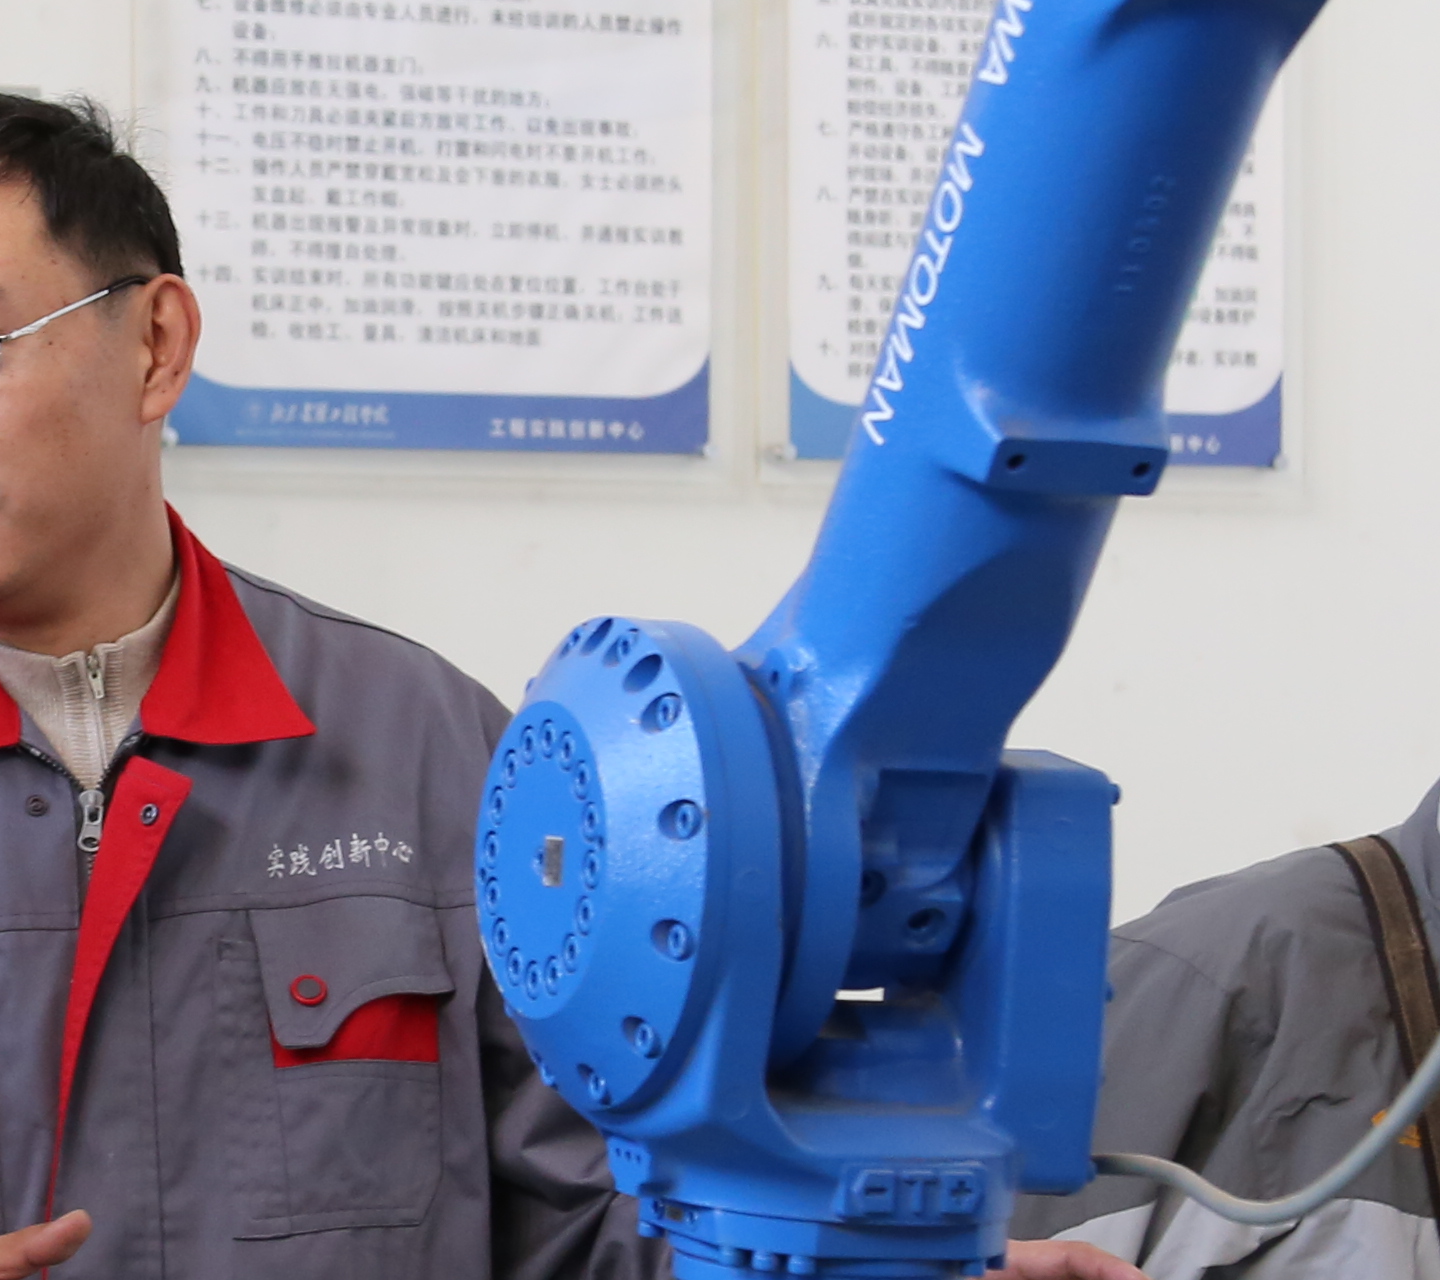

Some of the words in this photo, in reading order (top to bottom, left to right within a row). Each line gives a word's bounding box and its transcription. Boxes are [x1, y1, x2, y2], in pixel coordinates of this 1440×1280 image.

[862, 122, 984, 445] MOTOMAN
[266, 833, 414, 878] 实践创新中心
